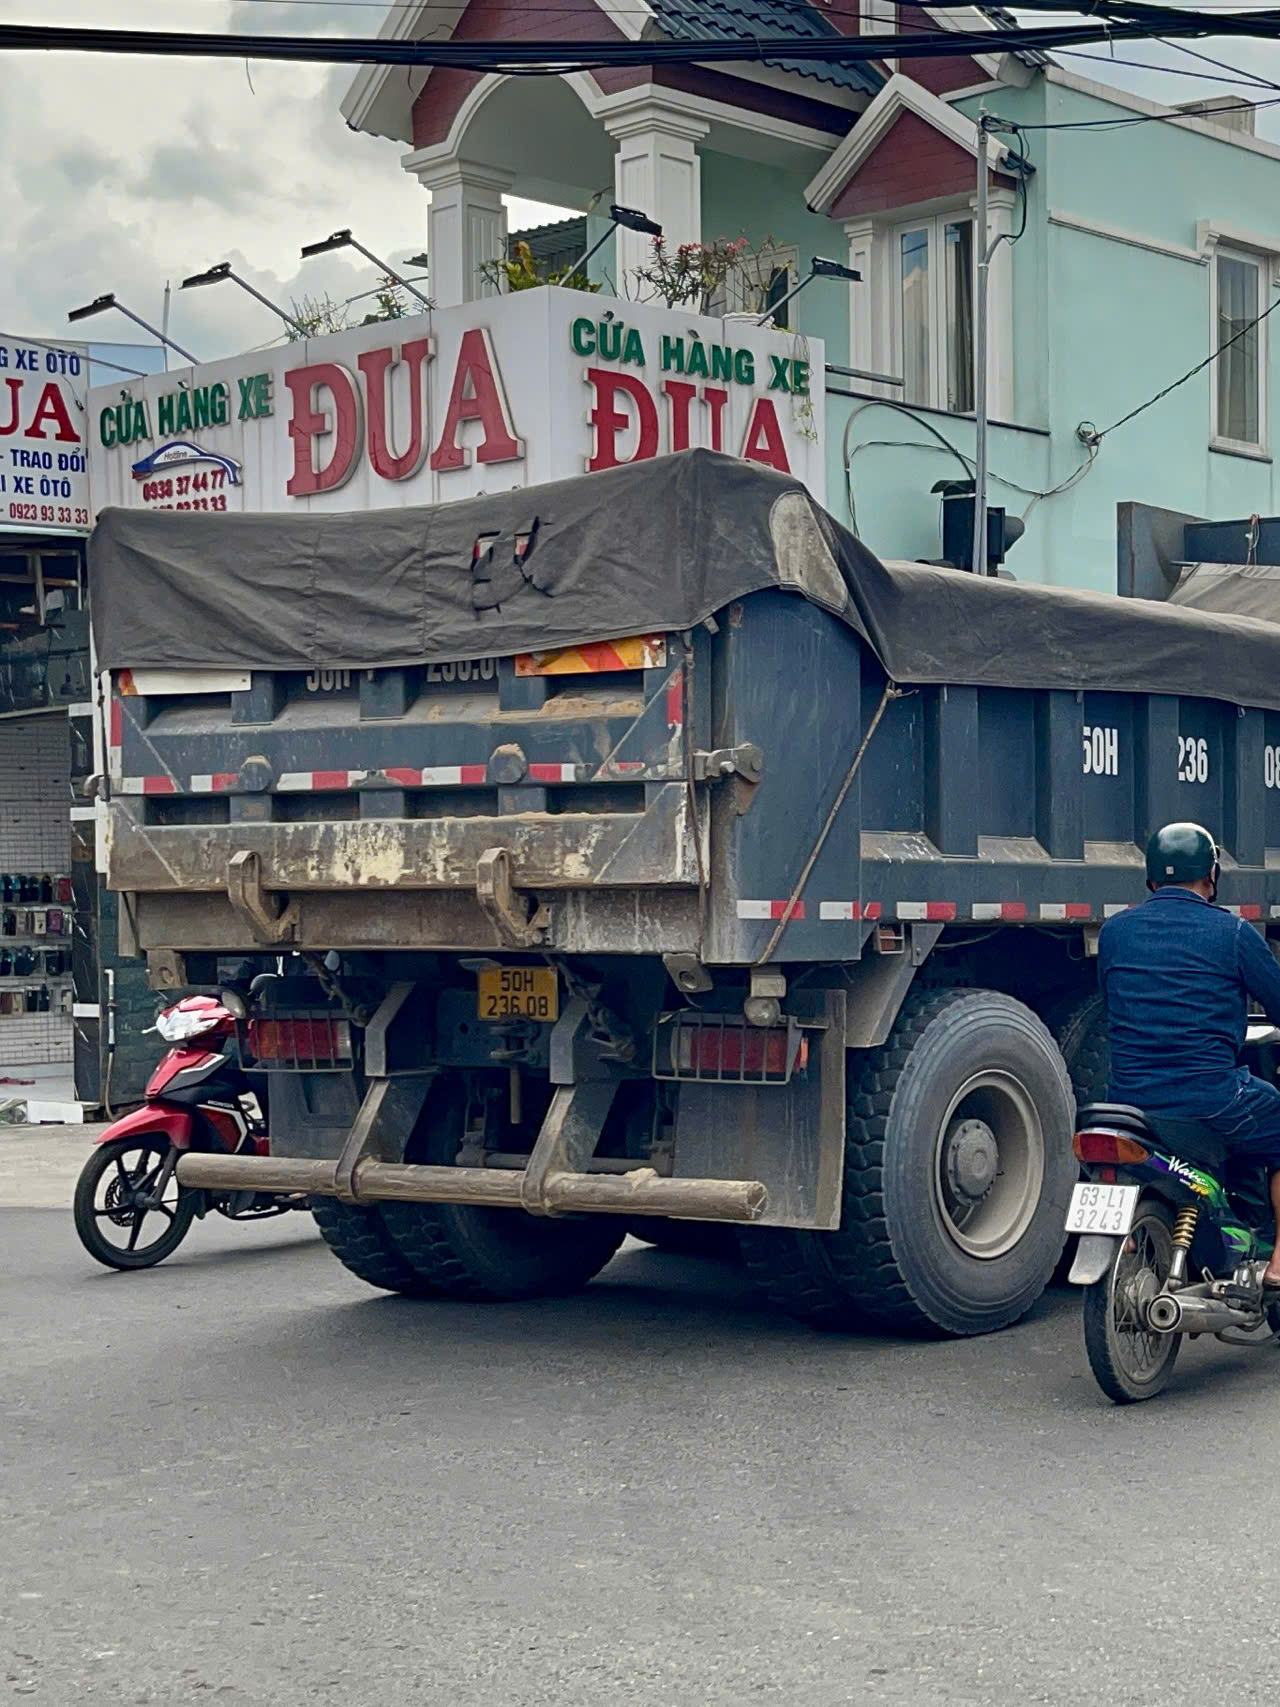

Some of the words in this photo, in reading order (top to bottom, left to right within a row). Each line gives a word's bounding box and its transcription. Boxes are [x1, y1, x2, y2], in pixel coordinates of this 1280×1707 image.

[15, 348, 40, 371] XE
[45, 348, 81, 376] ÔTÔ
[572, 311, 646, 367] CỬA
[660, 328, 756, 386] HÀNG
[768, 353, 811, 396] XE
[100, 388, 153, 448] CỬA
[157, 379, 230, 437] HÀNG
[237, 372, 274, 421] XE
[281, 328, 525, 498] ĐUA
[10, 448, 52, 469] TRAO
[57, 446, 86, 473] ĐỔI
[13, 475, 35, 495] XE
[40, 474, 71, 498] ÔTÔ
[143, 479, 173, 502] 0938
[176, 475, 191, 496] 37
[192, 471, 208, 493] 44
[210, 467, 227, 490] 77
[9, 502, 38, 520] 0923
[40, 505, 55, 522] 93
[57, 506, 72, 524] 33
[74, 508, 89, 525] 33
[1083, 726, 1119, 776] 50H
[1177, 736, 1208, 783] 236
[501, 970, 534, 992] 50H
[1168, 1155, 1210, 1189] Wave
[1079, 1186, 1126, 1209] 63-L1
[1074, 1209, 1124, 1231] 3243
